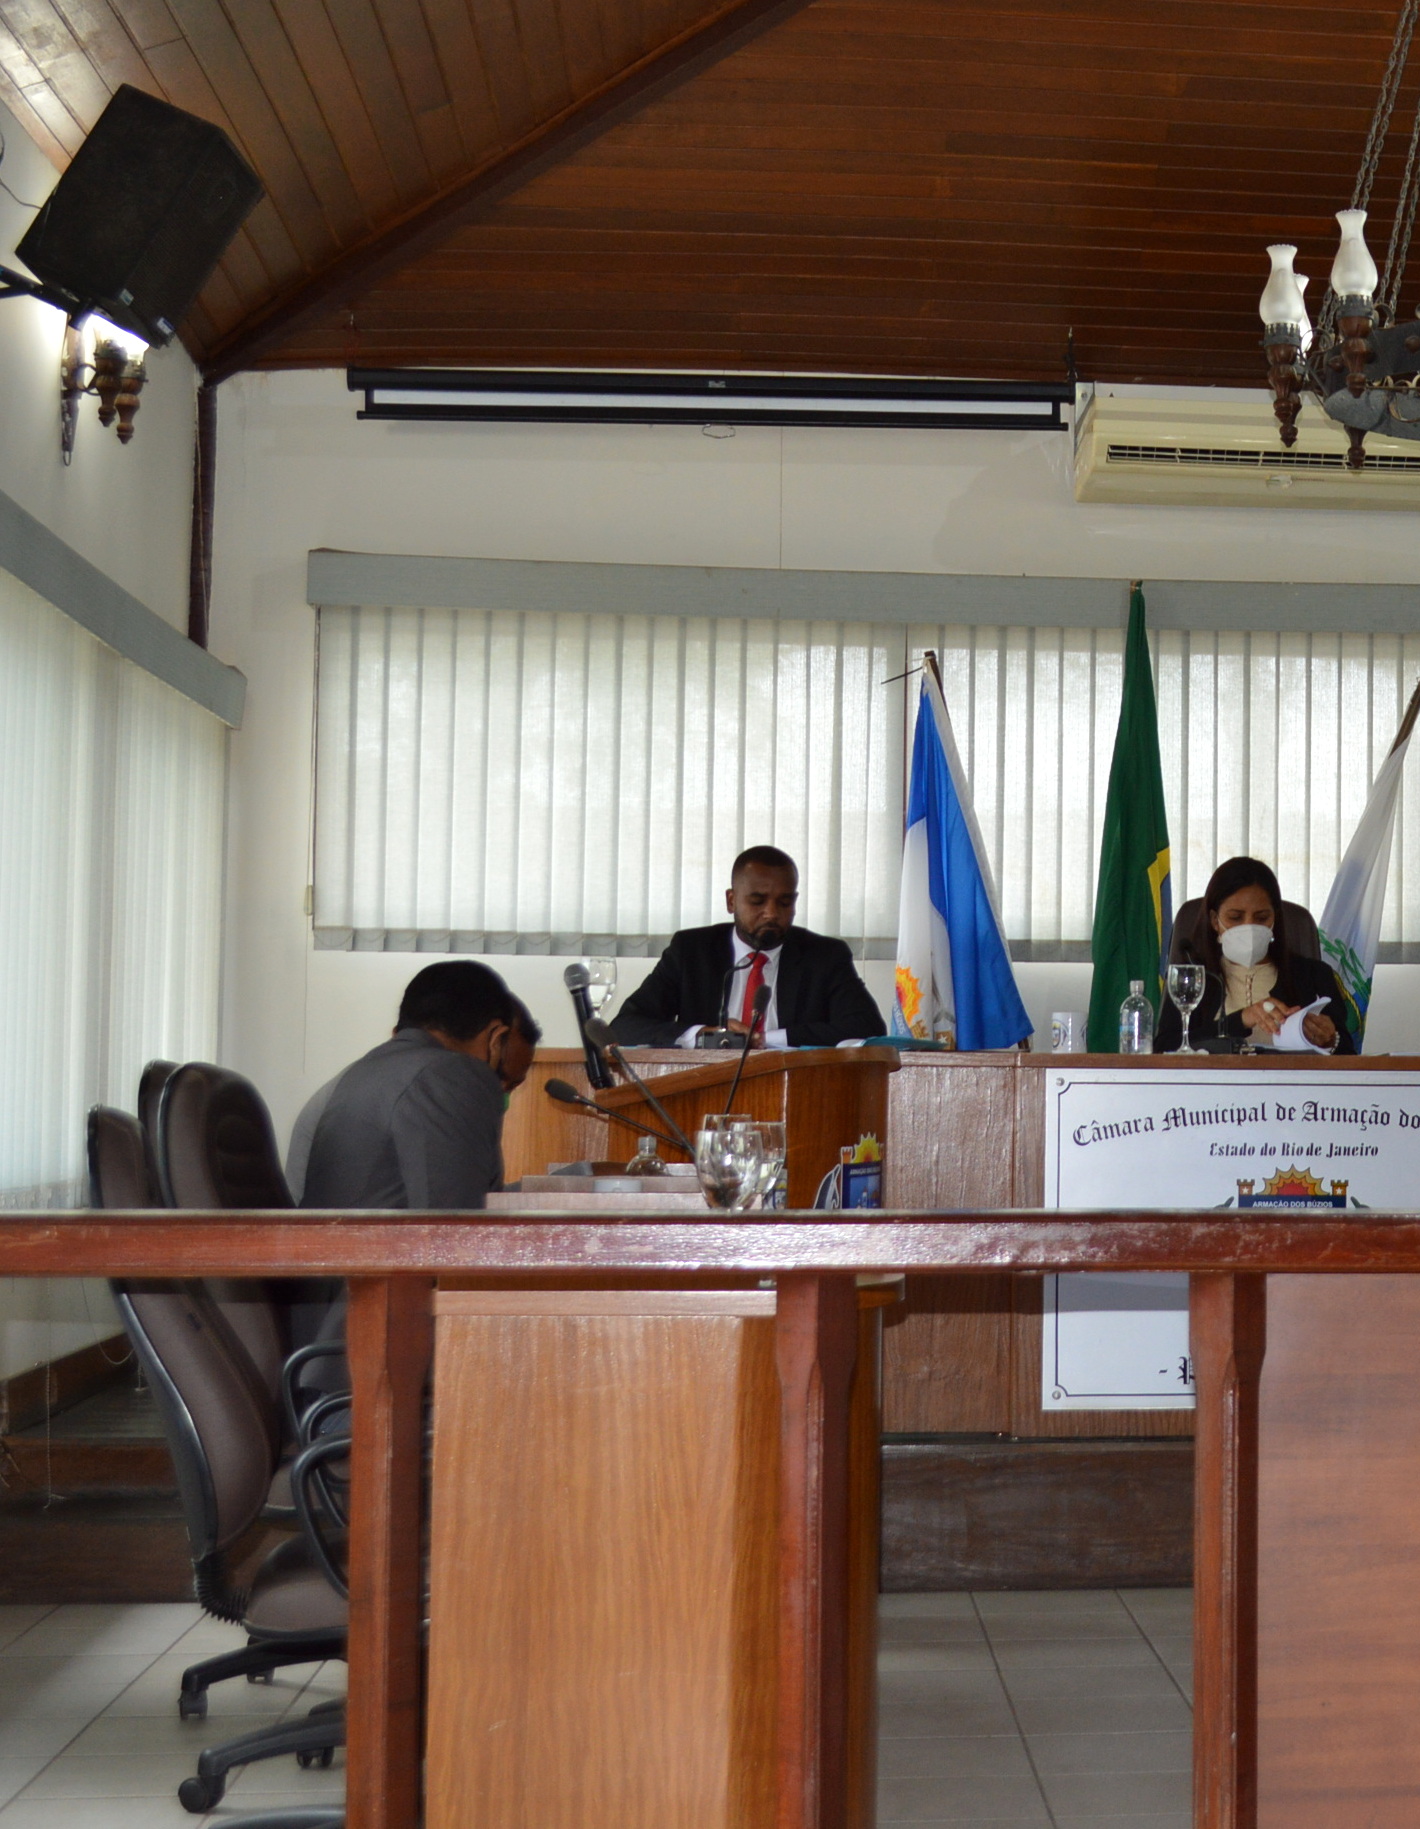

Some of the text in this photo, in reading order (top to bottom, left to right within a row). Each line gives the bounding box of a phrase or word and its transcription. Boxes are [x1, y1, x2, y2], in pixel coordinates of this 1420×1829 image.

[1072, 1116, 1155, 1147] Câmara
[1162, 1101, 1268, 1132] Municipal
[1275, 1101, 1297, 1122] de
[1302, 1100, 1391, 1131] Armação
[1209, 1142, 1379, 1158] Estado do Rio de Janeiro
[1252, 1200, 1289, 1208] ARMAÇÃO
[1307, 1200, 1333, 1208] BÚZIOS
